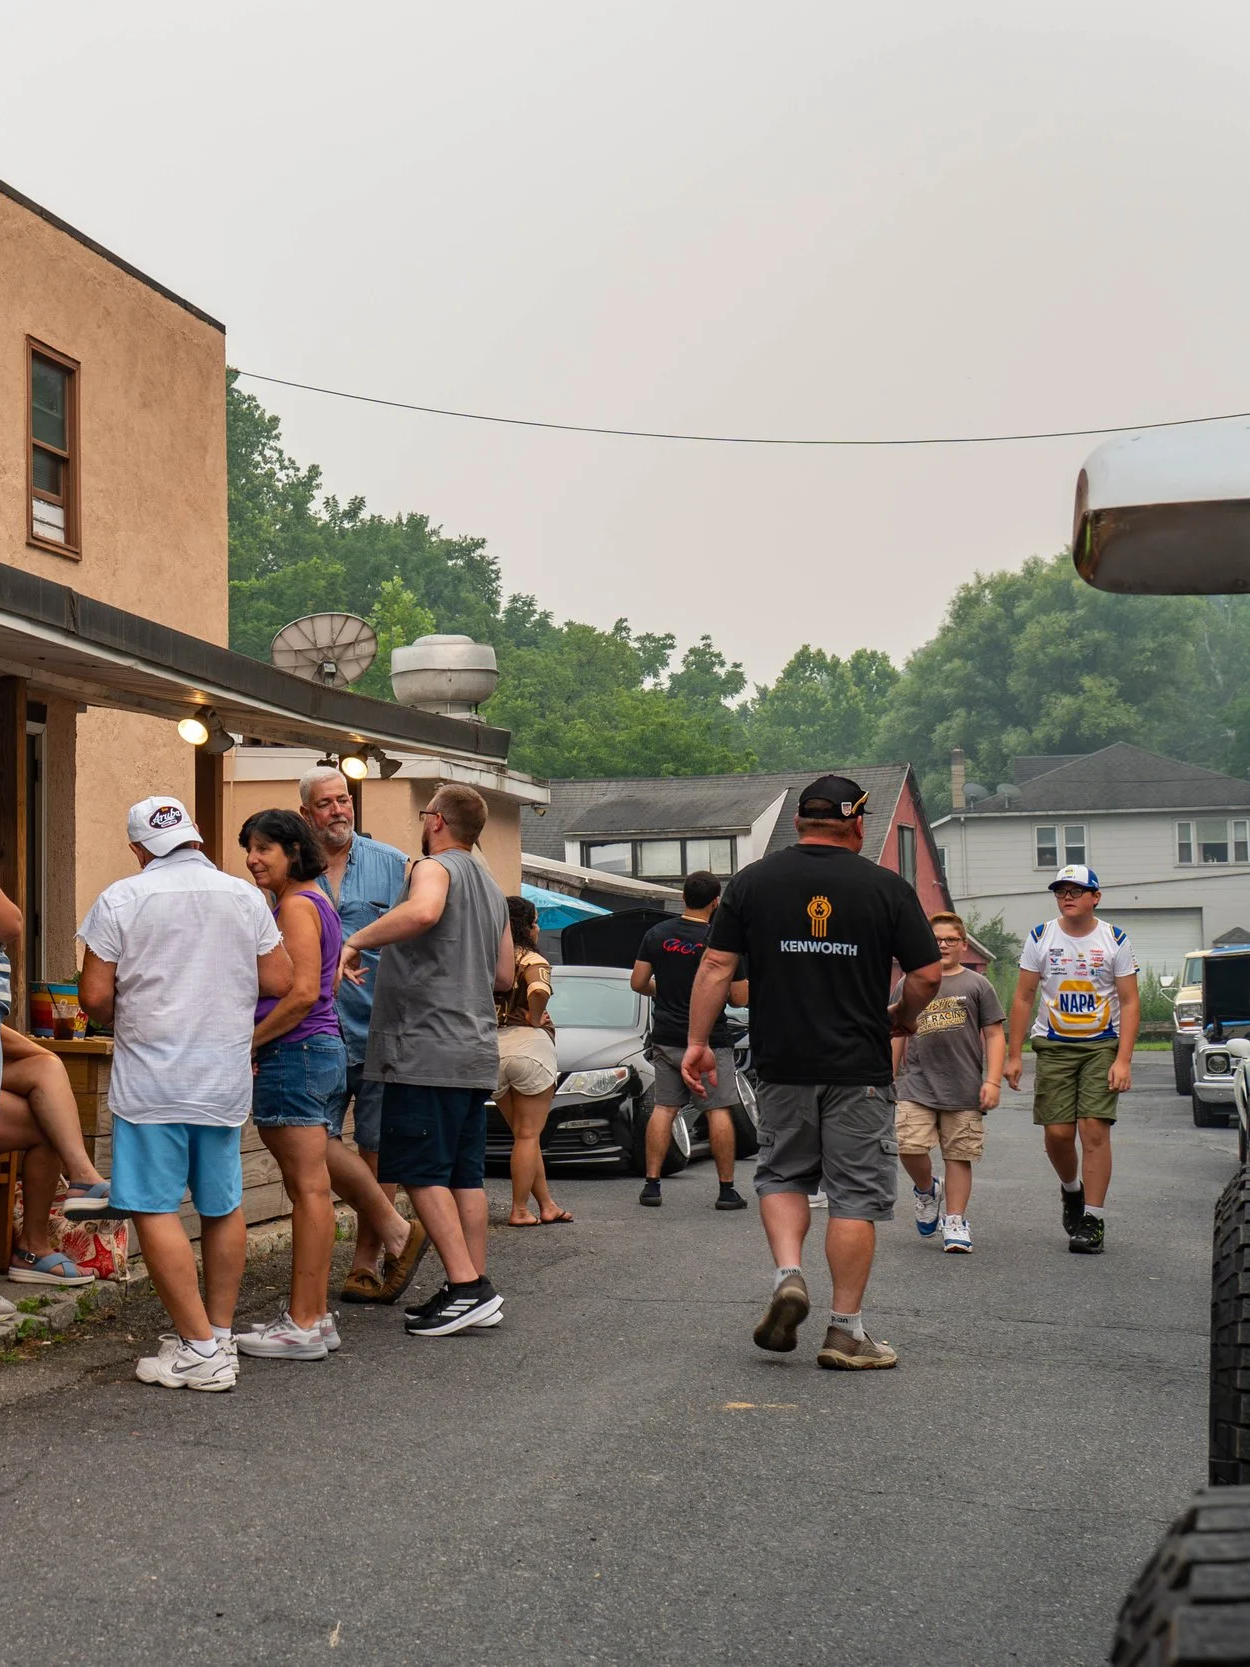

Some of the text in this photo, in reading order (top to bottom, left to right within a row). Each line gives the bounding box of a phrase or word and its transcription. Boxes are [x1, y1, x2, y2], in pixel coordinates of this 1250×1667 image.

[151, 808, 181, 825] Aruba
[780, 941, 857, 956] KENWORTH
[1060, 994, 1095, 1012] NAPA
[931, 1010, 967, 1022] RACING
